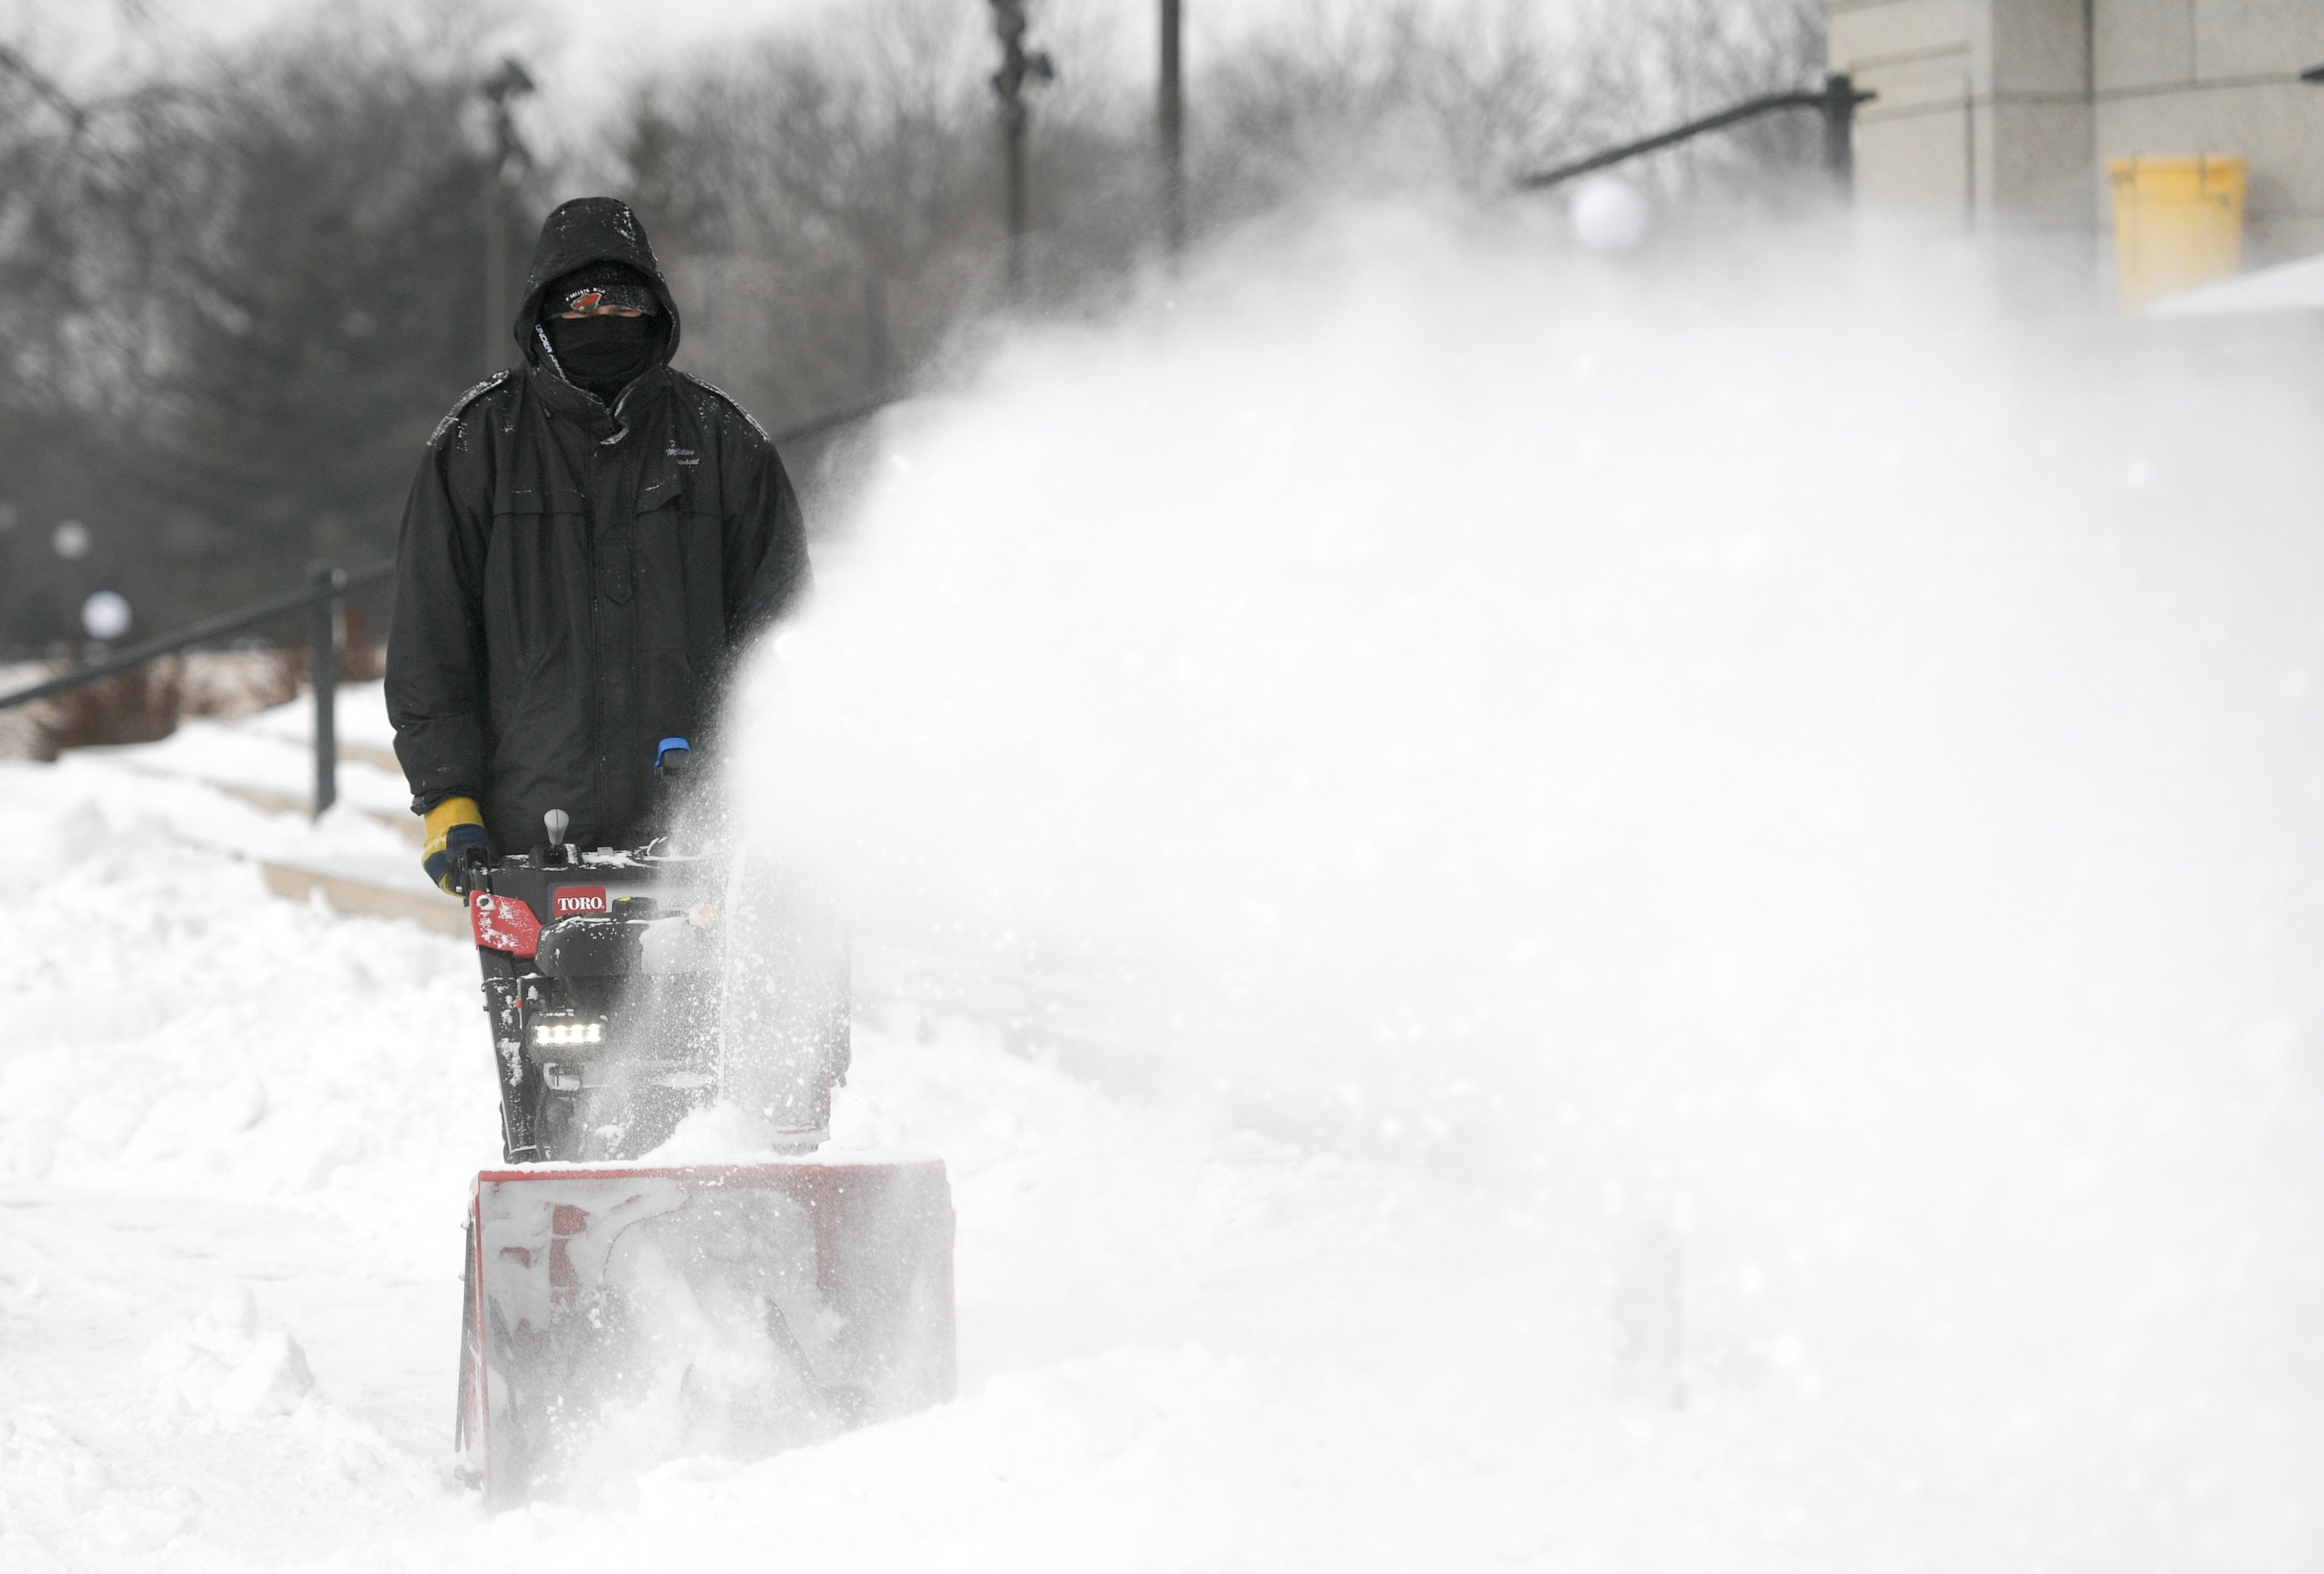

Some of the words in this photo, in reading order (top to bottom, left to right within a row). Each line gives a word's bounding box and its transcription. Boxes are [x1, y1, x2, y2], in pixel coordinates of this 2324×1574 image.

[535, 324, 552, 353] UNDER
[549, 354, 567, 382] ARMOU
[557, 897, 602, 911] TORO
